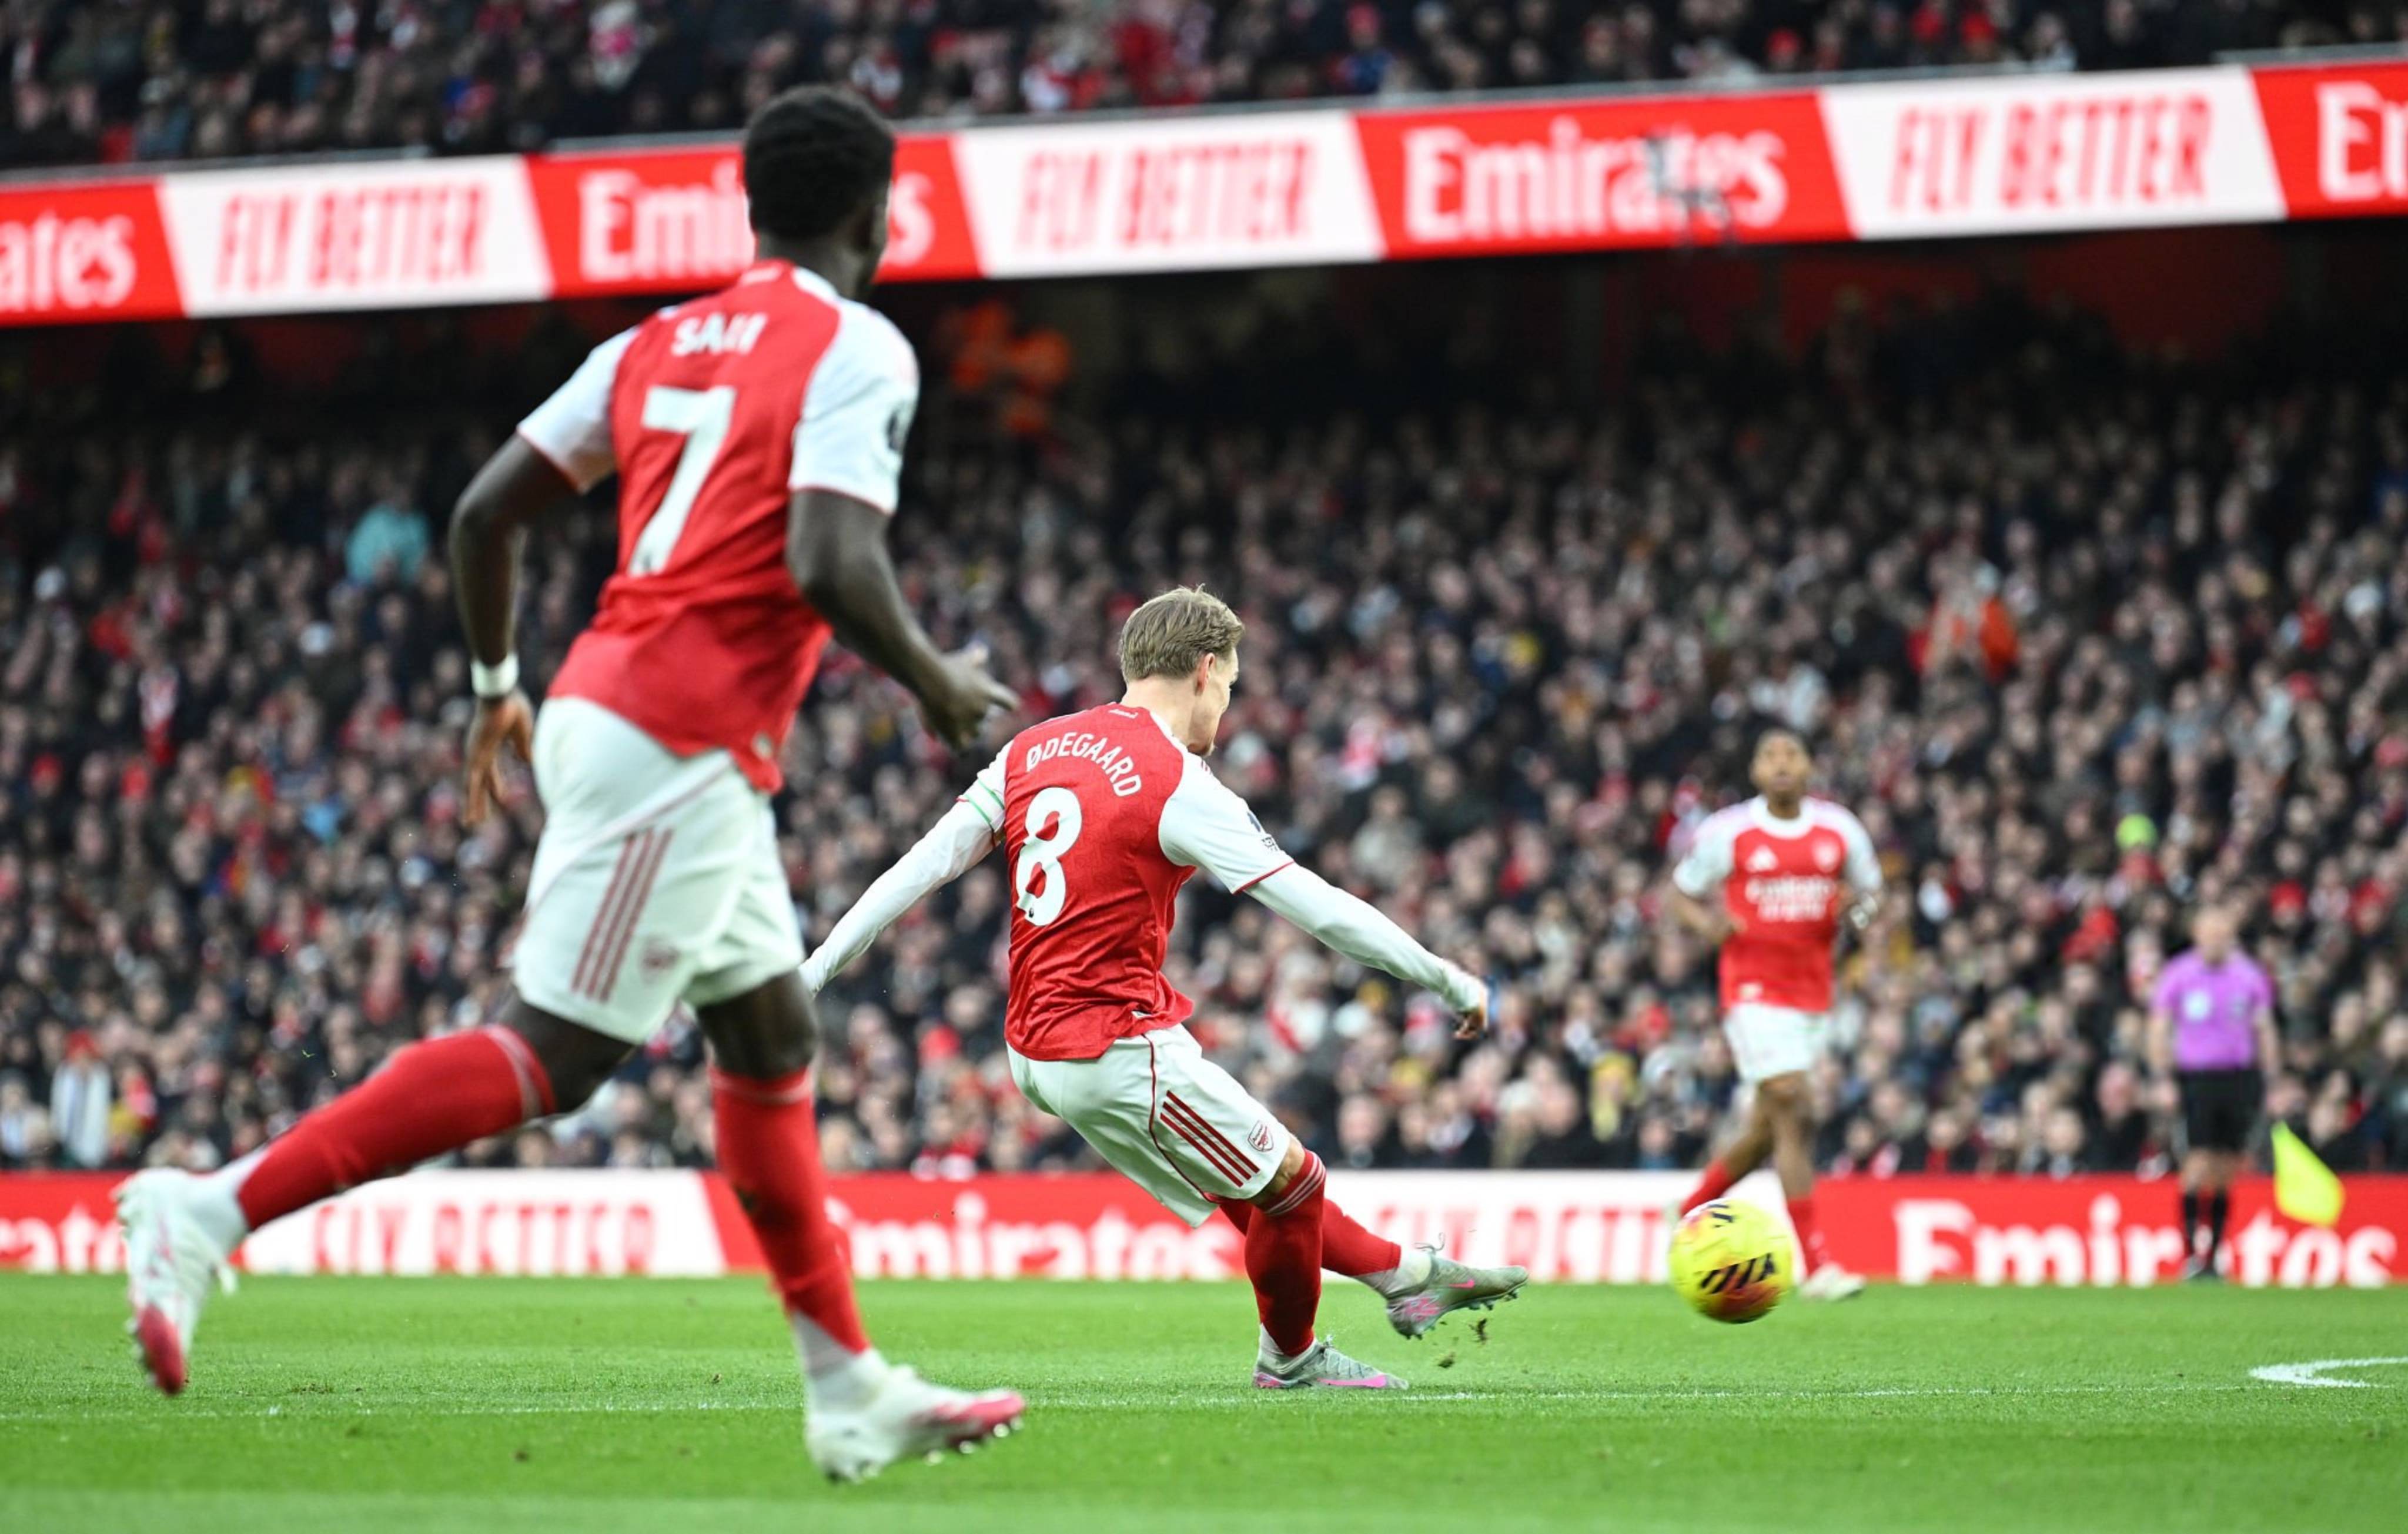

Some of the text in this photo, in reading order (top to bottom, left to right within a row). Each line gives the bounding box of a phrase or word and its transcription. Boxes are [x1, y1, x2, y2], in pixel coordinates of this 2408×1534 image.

[1403, 115, 1788, 242] Emirates
[1889, 93, 2212, 212] FLY BETTER
[628, 384, 737, 577] 7
[1025, 732, 1142, 797] ØDEGAARD
[1016, 786, 1082, 927] 8
[825, 1191, 1243, 1281] mirates
